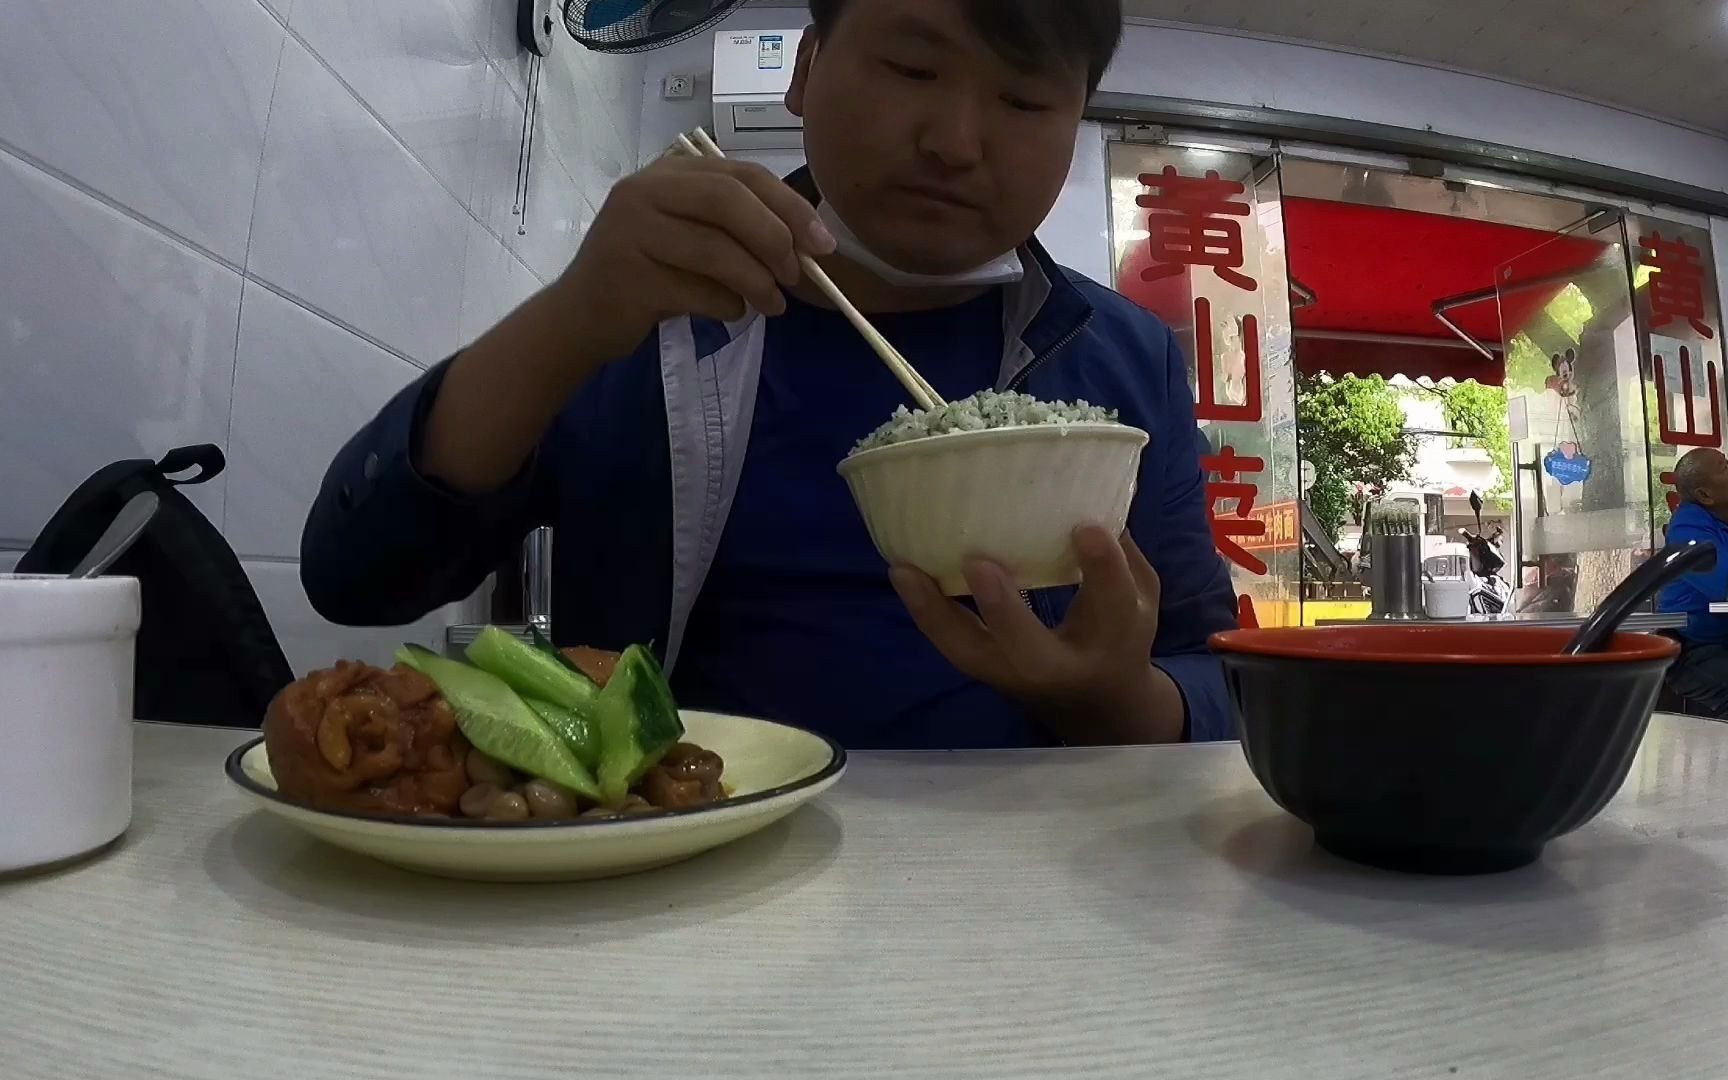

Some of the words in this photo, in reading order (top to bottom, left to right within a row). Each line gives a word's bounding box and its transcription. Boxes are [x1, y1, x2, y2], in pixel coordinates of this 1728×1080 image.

[1136, 165, 1268, 628] 黄山菜
[1638, 230, 1722, 513] 黄山
